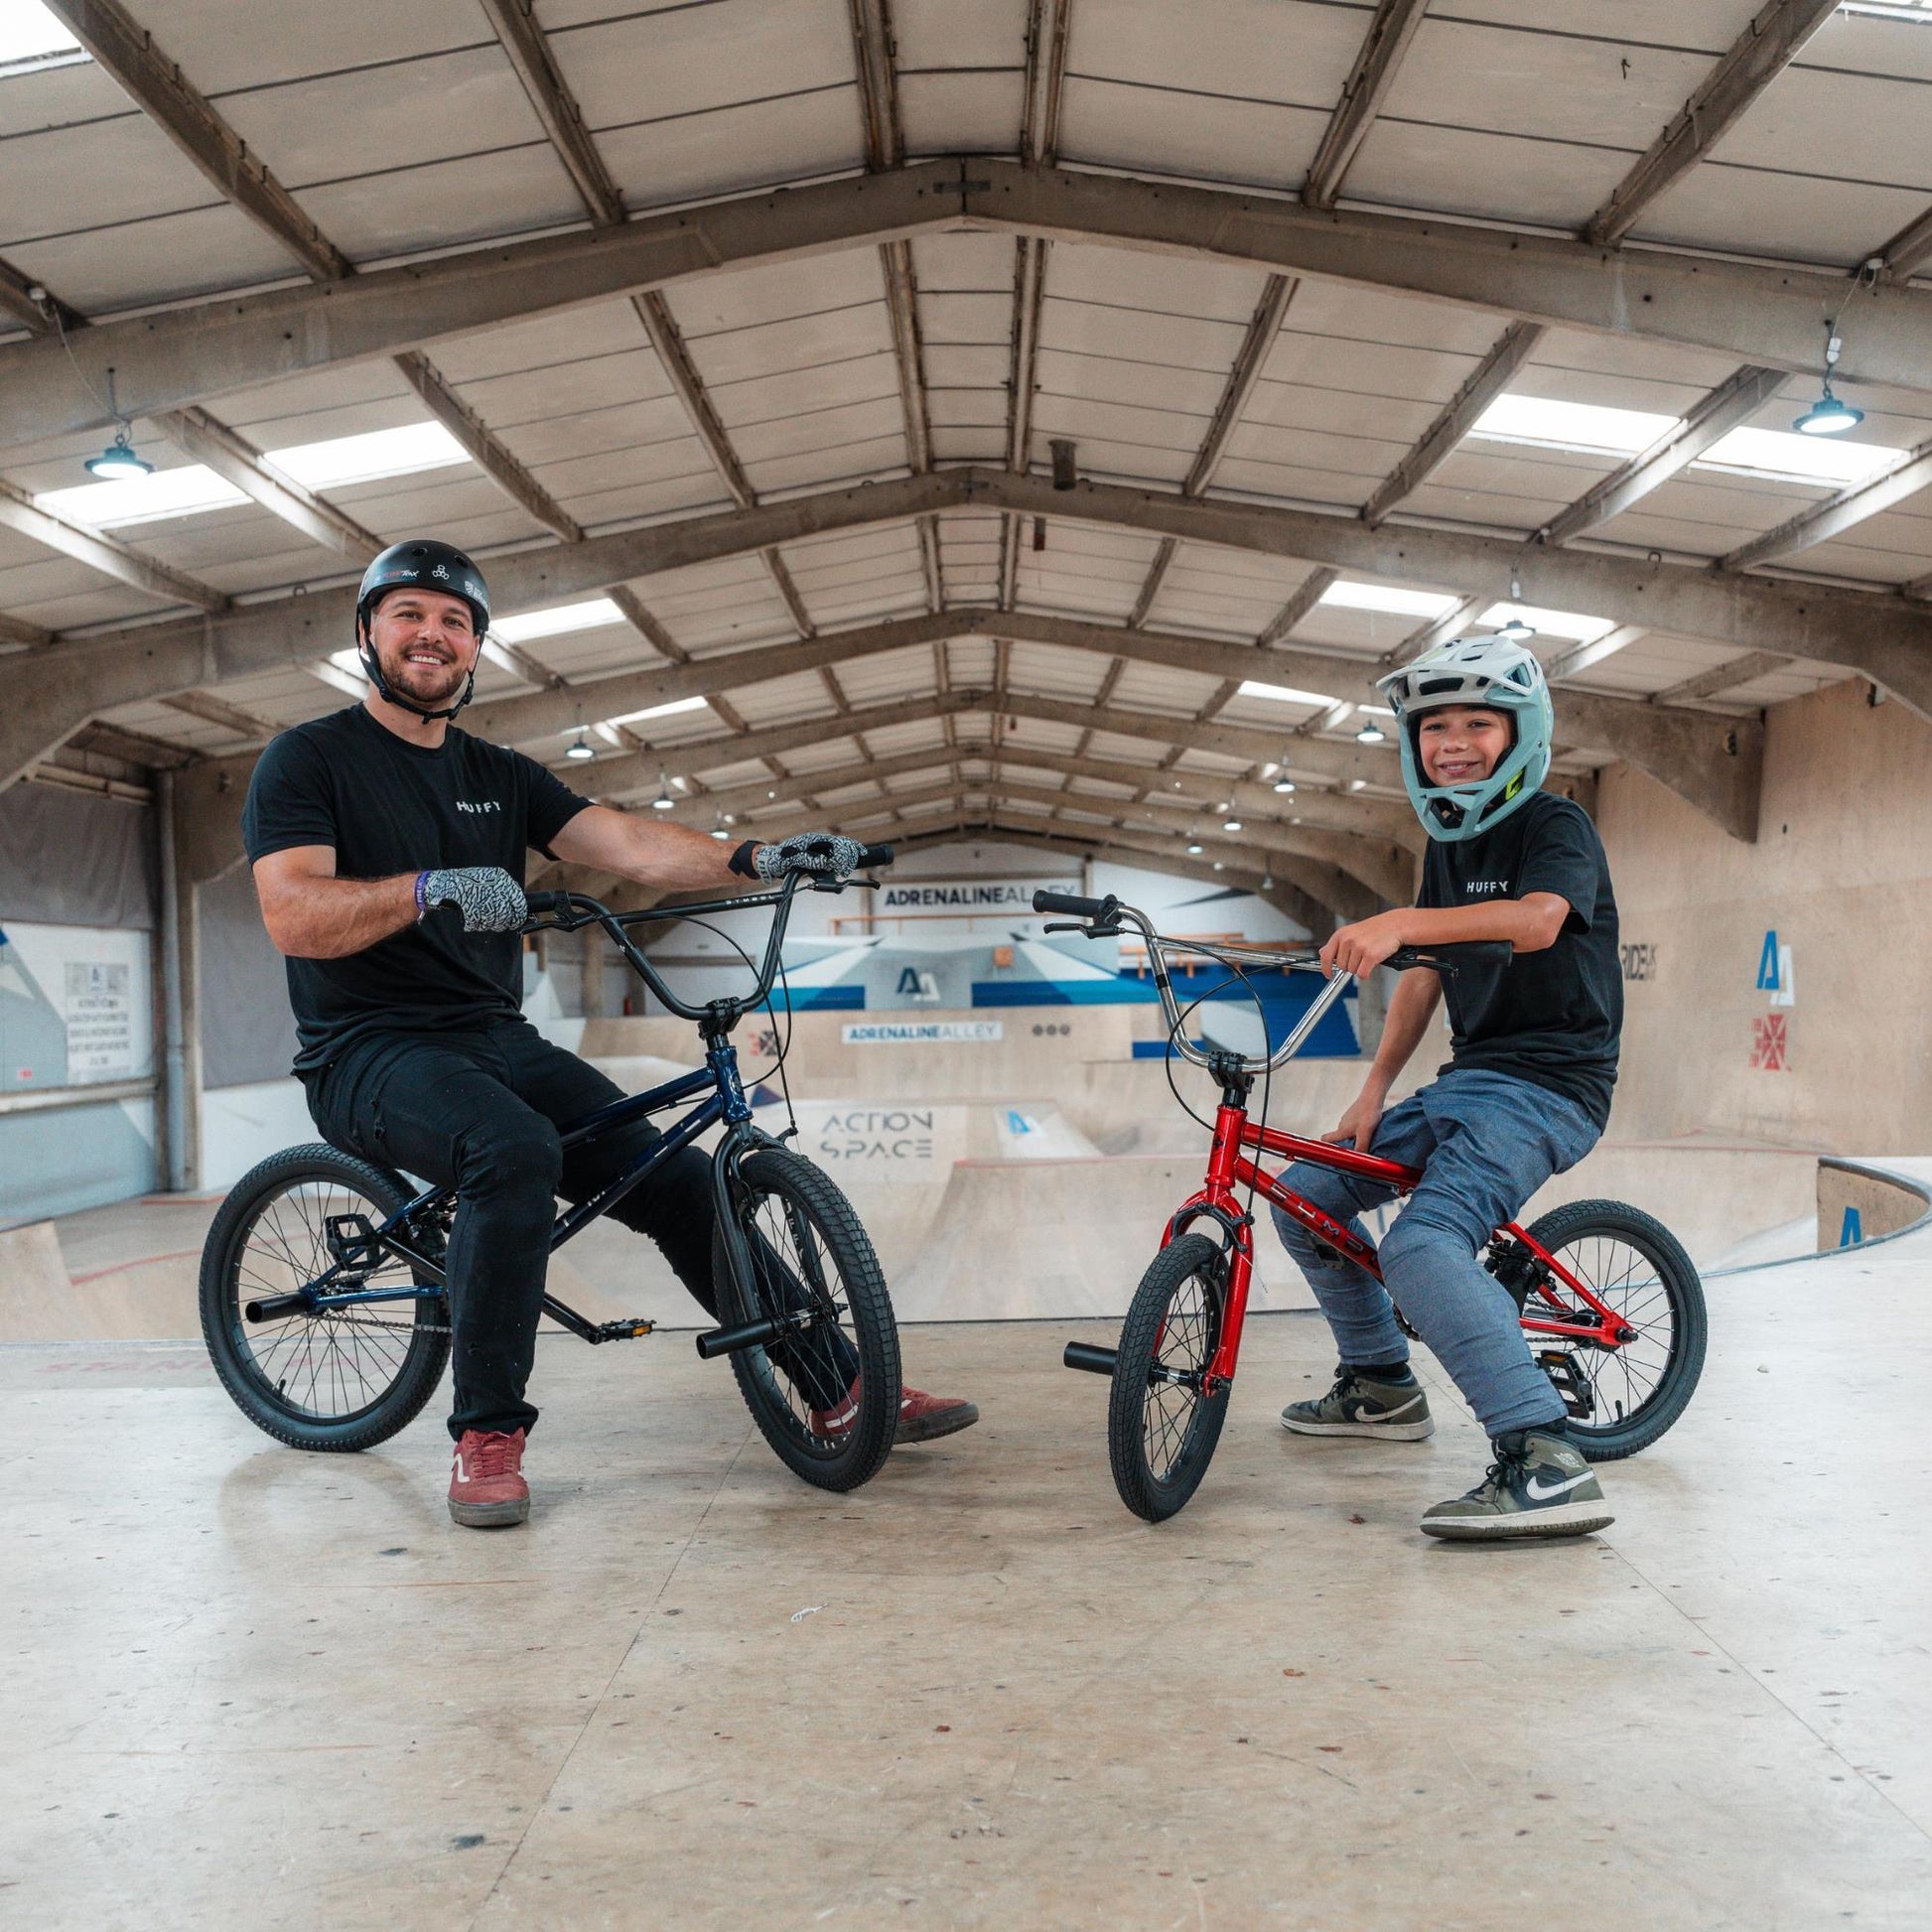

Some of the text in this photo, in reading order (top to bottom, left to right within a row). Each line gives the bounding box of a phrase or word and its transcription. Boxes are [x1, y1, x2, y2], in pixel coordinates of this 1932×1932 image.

[456, 800, 500, 813] HUFFY
[885, 884, 1075, 905] ADRENALINEALY
[1466, 881, 1509, 894] HUFFY
[821, 1111, 932, 1132] ACTION
[819, 1139, 932, 1159] SPACE
